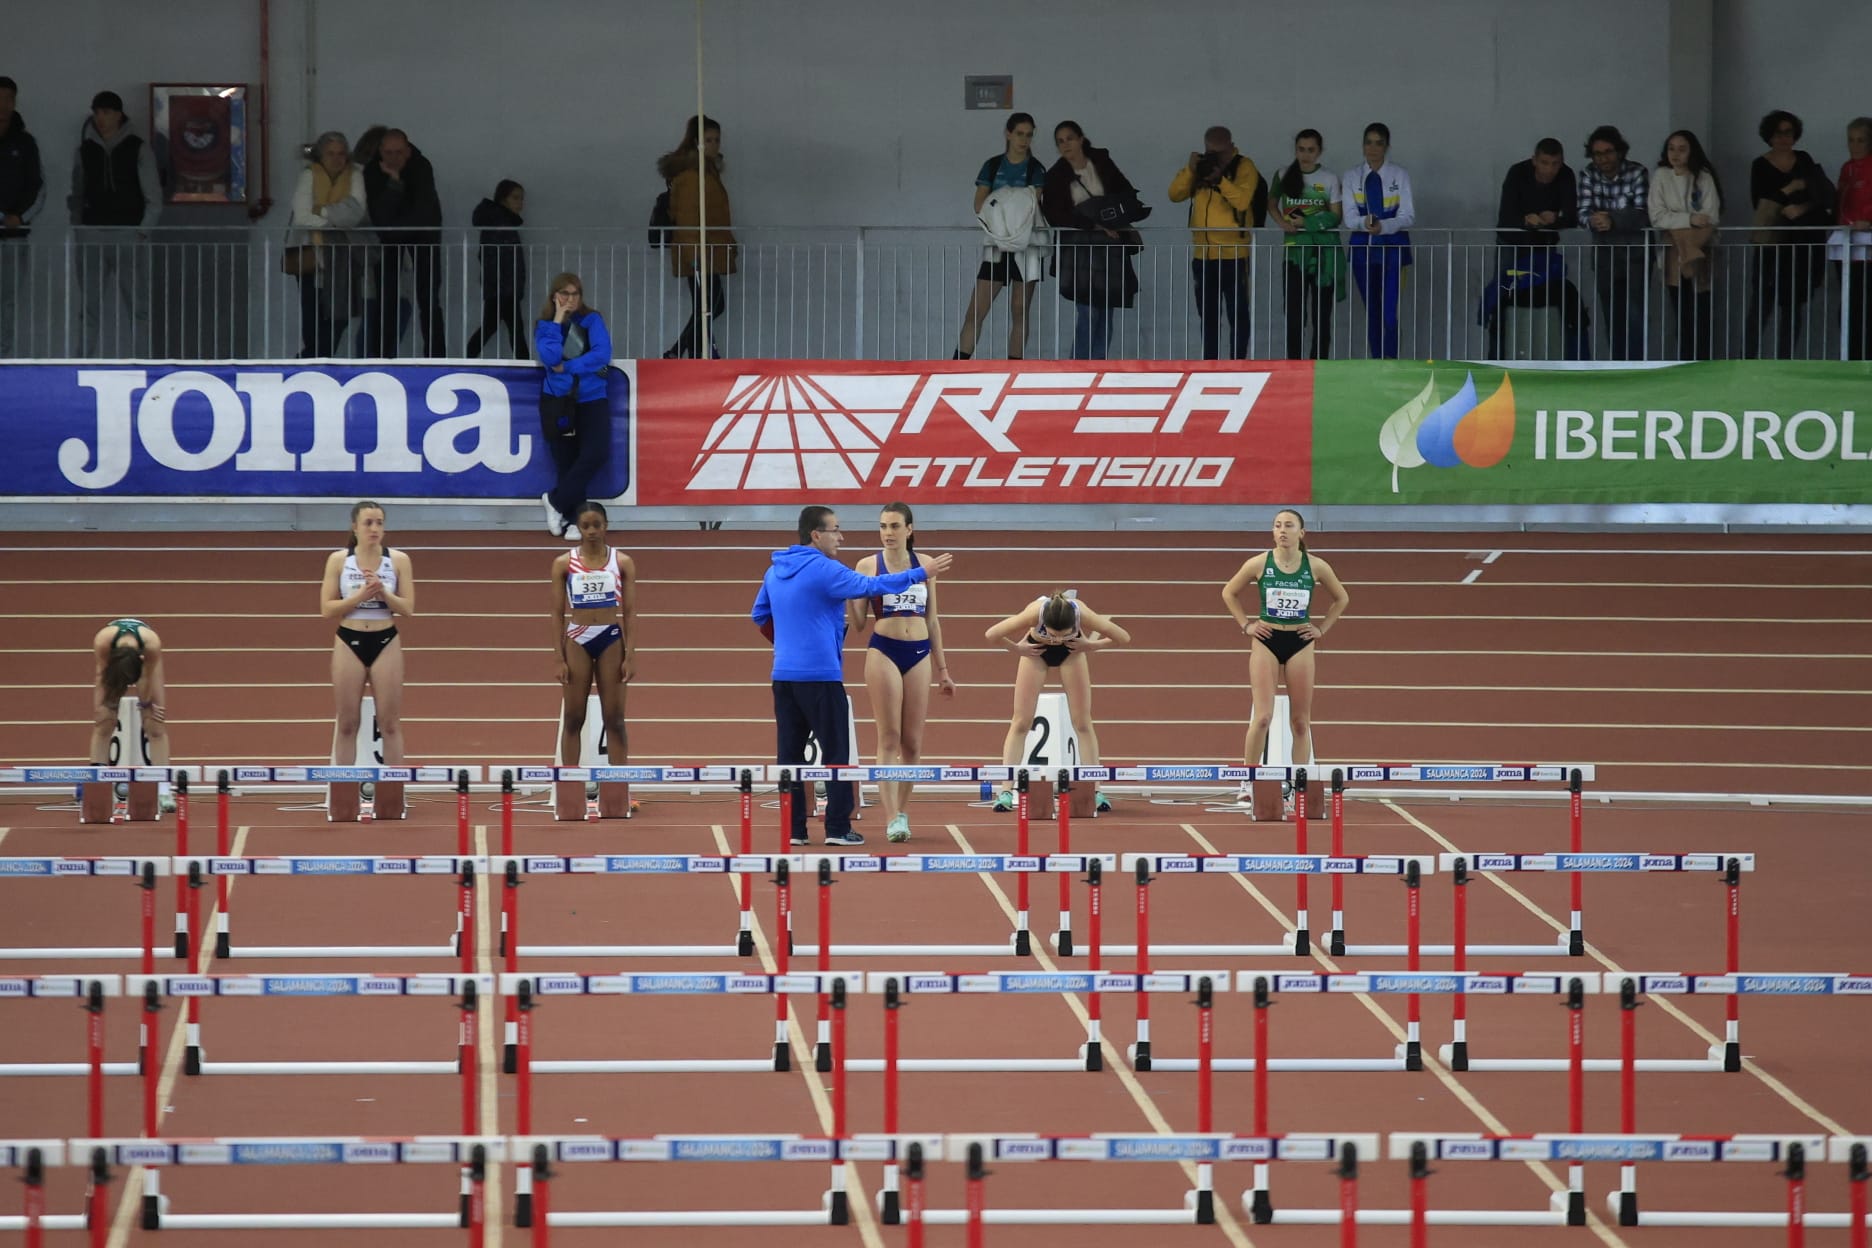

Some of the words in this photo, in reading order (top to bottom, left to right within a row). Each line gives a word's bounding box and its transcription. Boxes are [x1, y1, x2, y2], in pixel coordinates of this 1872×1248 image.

[901, 372, 1272, 452] RFEA
[58, 370, 532, 489] Joma
[881, 457, 1236, 487] ATLETISMO
[582, 582, 606, 593] 337
[894, 594, 917, 604] 373
[1277, 598, 1300, 609] 322
[1028, 716, 1050, 765] 2
[875, 769, 915, 780] SALAMANCA
[918, 769, 935, 780] 2024
[1152, 769, 1193, 780] SALAMANCA
[1195, 769, 1213, 780] 2024
[1427, 769, 1468, 779] SALAMANCA
[1470, 769, 1488, 779] 2024
[928, 857, 975, 869] SALAMANCA
[978, 857, 998, 869] 2024
[1245, 858, 1292, 870] SALAMANCA
[1295, 858, 1315, 870] 2024
[1563, 856, 1610, 869] SALAMANCA
[1613, 856, 1633, 869] 2024
